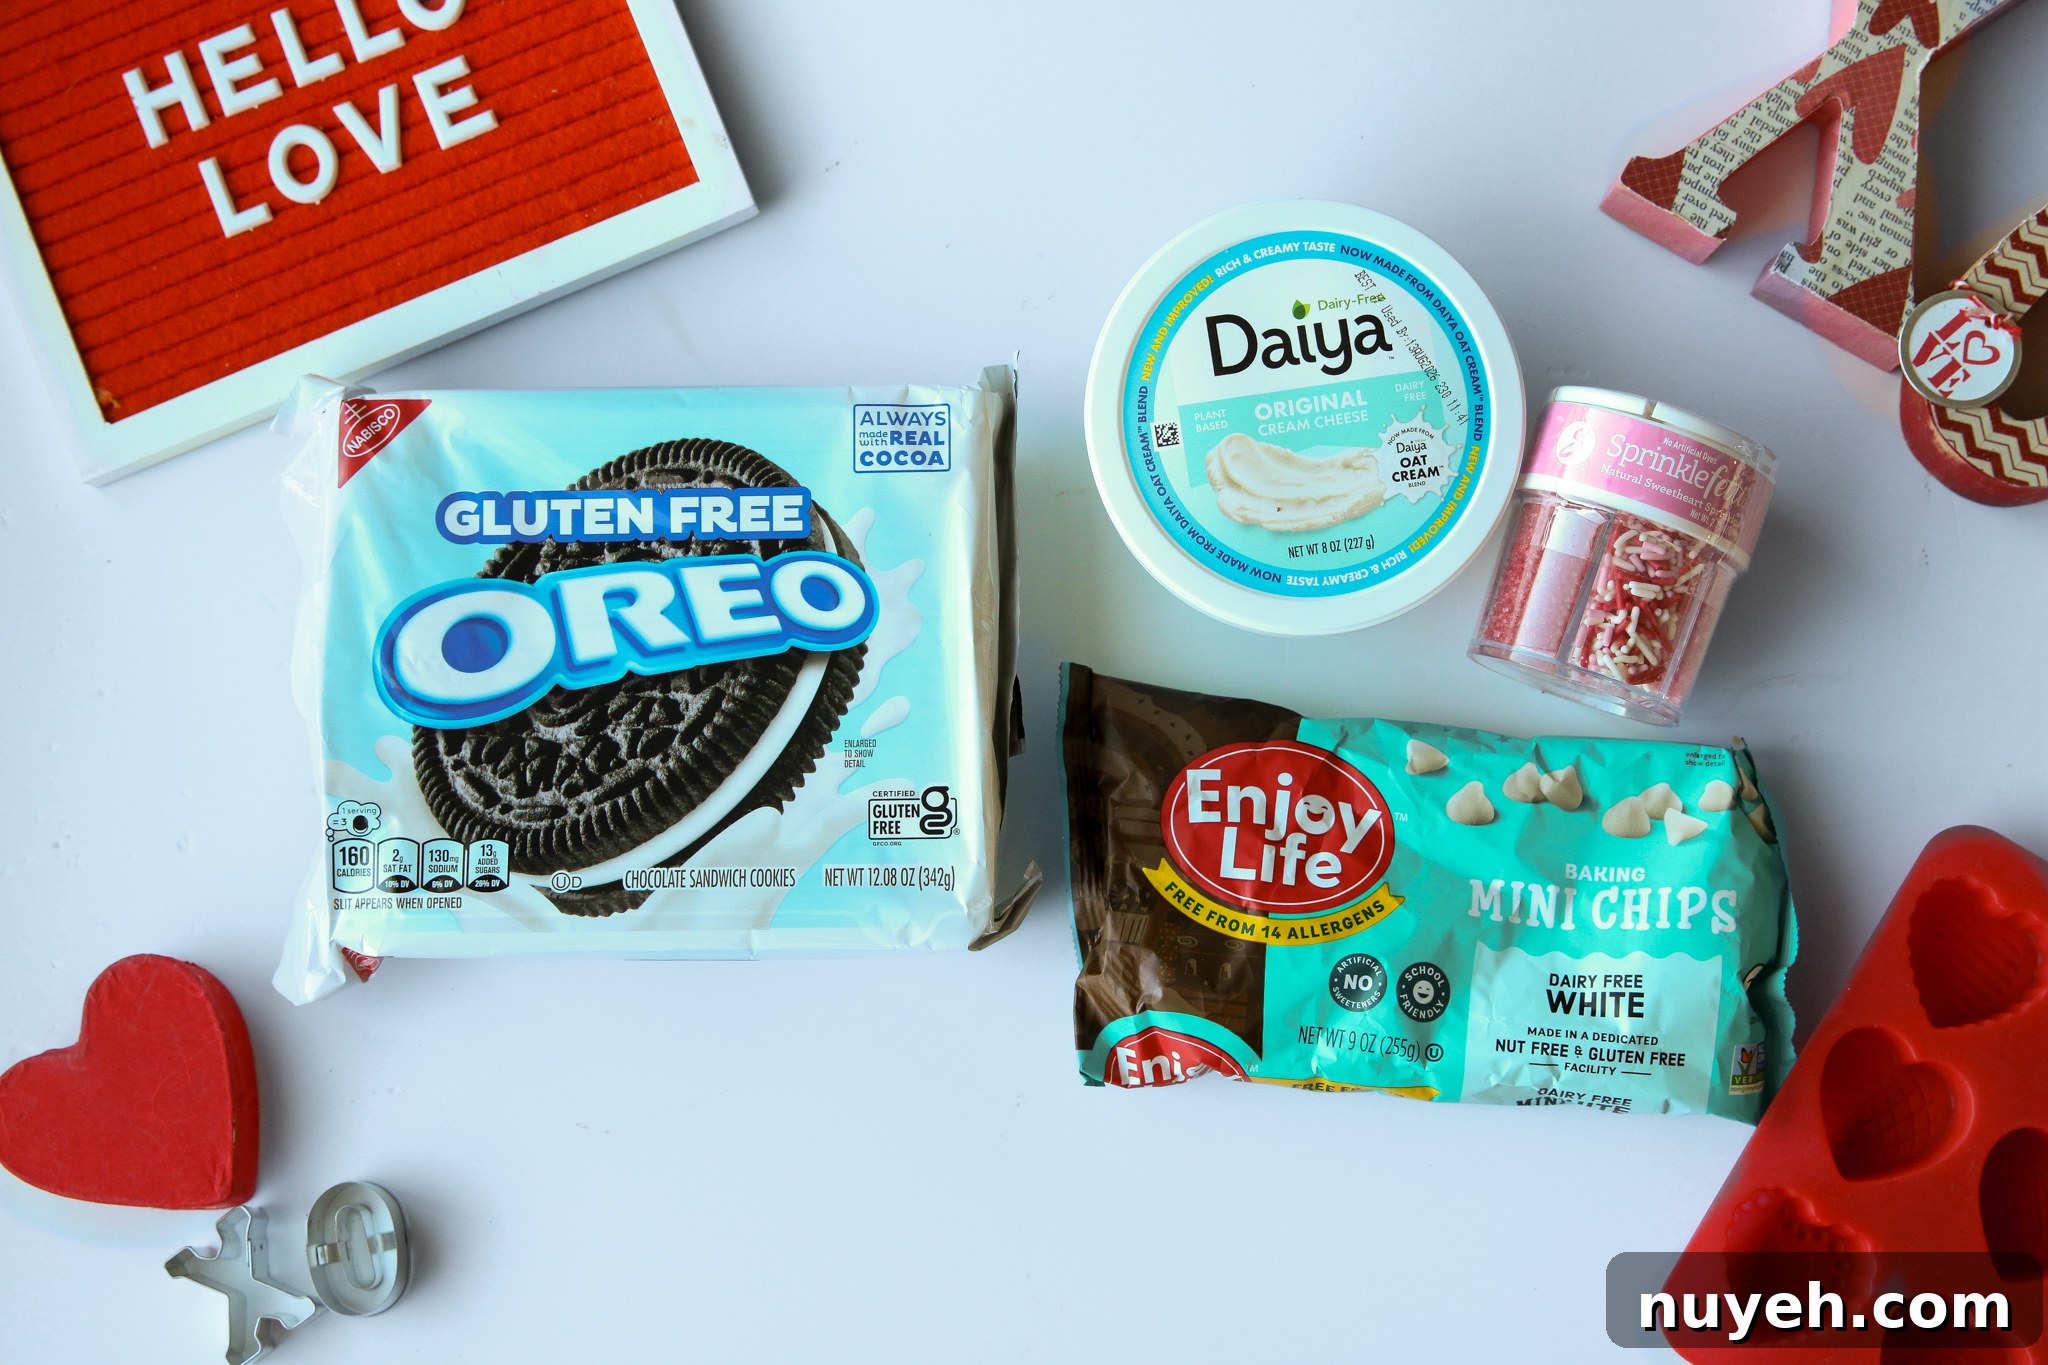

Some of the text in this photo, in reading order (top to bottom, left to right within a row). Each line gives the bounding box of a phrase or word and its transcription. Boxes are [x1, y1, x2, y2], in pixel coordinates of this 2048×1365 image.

[1743, 127, 1762, 144] the
[199, 54, 498, 238] LOVE
[1709, 143, 1735, 164] they
[1853, 192, 1878, 210] and
[1860, 180, 1892, 203] every
[1214, 241, 1335, 279] RICH & CREAMY TASTE
[1355, 270, 1376, 291] BEST
[1318, 293, 1386, 311] Dairy-Free
[1141, 274, 1215, 381] NEW AND IMPROVED!
[1340, 245, 1373, 261] NOW
[1373, 255, 1406, 278] MADE
[1404, 273, 1434, 301] FROM
[1432, 298, 1459, 332] DAIYA
[1454, 331, 1472, 353] OAT
[1473, 404, 1484, 442] BLEND
[1395, 381, 1424, 393] DAIRY
[1404, 391, 1427, 402] FREE
[1138, 386, 1149, 423] BLEND
[1255, 390, 1367, 421] ORIGINAL
[860, 411, 947, 427] ALWAYS
[1195, 409, 1226, 422] PLANT
[1258, 409, 1368, 436] CREAM CHEESE
[347, 408, 395, 453] NABISCO
[859, 430, 888, 438] made
[1196, 420, 1228, 432] BASED
[859, 438, 888, 446] with
[890, 431, 945, 446] REAL
[1388, 427, 1434, 445] NOW MADE FROM
[1396, 441, 1427, 454] Daiya
[1663, 437, 1718, 465] No Artificial Dyes
[860, 450, 944, 466] COCOA
[1400, 455, 1427, 468] OAT
[1150, 475, 1167, 496] OAT
[1600, 463, 1704, 509] Natural Sweetheart
[1408, 445, 1480, 553] NEW AND IMPROVED!
[444, 493, 805, 537] GLUTEN FREE
[1163, 496, 1190, 530] DAIYA
[1187, 528, 1217, 557] FROM
[1288, 545, 1304, 559] NET
[1306, 543, 1319, 557] WT
[1321, 542, 1327, 553] 8
[1330, 539, 1342, 553] OZ
[1216, 551, 1249, 575] MADE
[1286, 550, 1408, 586] RICH & CREAMY TASTE
[1250, 567, 1282, 584] NOW
[392, 558, 870, 682] OREO
[844, 739, 877, 748] ENLARGED
[844, 749, 873, 758] TO SHOW
[1686, 752, 1716, 760] enlarged
[844, 760, 865, 768] DETAIL
[347, 807, 377, 816] serving
[873, 804, 920, 818] GLUTEN
[1186, 769, 1382, 854] Enjoy
[873, 821, 901, 834] FREE
[339, 846, 370, 866] 160
[392, 849, 404, 863] 2g
[428, 849, 459, 863] 130mg
[480, 844, 497, 857] 13g
[1220, 826, 1342, 889] Life
[336, 868, 372, 878] CALORIES
[383, 864, 412, 873] SAT FAT
[428, 865, 458, 873] SODIUM
[1565, 863, 1646, 882] BAKING
[400, 880, 410, 888] DV
[443, 880, 454, 888] DV
[491, 879, 501, 887] DV
[625, 868, 796, 889] CHOCOLATE SANDWICH COOKIES
[824, 865, 956, 892] NET WT 12.08 OZ (342g)
[333, 897, 462, 911] SLIT APPEARS WHEN OPENED
[1164, 881, 1385, 939] FREE FROM 14 ALLERGENS
[1468, 878, 1737, 934] MINI CHIPS
[1336, 956, 1383, 977] ARTIFICIAL
[1405, 965, 1446, 987] SCHOOL
[1344, 974, 1373, 991] NO
[1549, 973, 1643, 989] DAIRY FREE
[1332, 986, 1381, 1009] SWEETENERS
[1400, 994, 1444, 1019] FRIENDLY
[1546, 989, 1645, 1018] WHITE
[1298, 1025, 1420, 1062] NET WT 9 OZ (255g)
[1527, 1026, 1658, 1046] MADE IN A DEDICATED
[1495, 1039, 1686, 1067] NUT FREE & GLUTEN FREE
[1564, 1062, 1617, 1076] FACILITY
[1591, 1095, 1632, 1107] FREE
